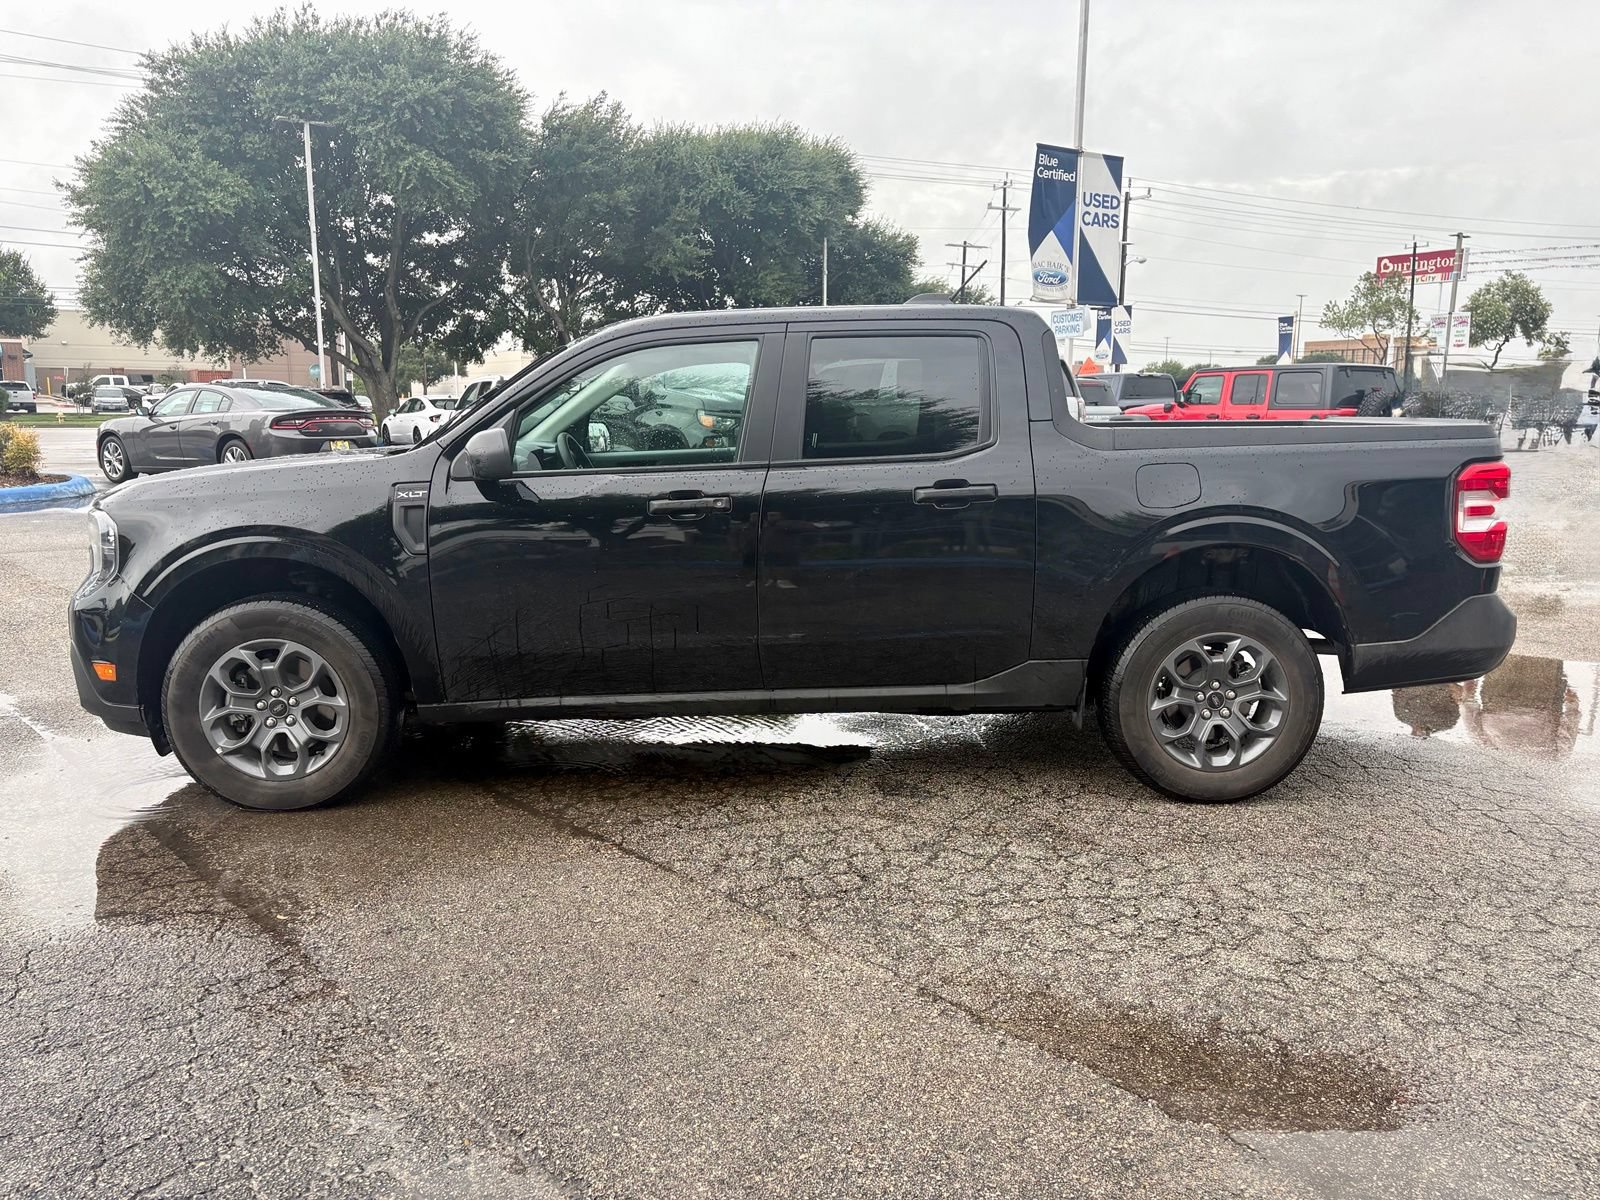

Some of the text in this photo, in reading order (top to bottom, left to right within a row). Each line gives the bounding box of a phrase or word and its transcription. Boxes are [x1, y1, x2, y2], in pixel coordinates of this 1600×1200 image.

[1038, 153, 1058, 167] Blue
[1037, 166, 1076, 182] Certified
[1083, 192, 1120, 210] USED
[1082, 211, 1120, 229] CARS
[1038, 270, 1061, 285] Ford
[1052, 312, 1083, 324] CUSTOMER
[1055, 324, 1081, 335] PARKING
[397, 490, 428, 498] XLT
